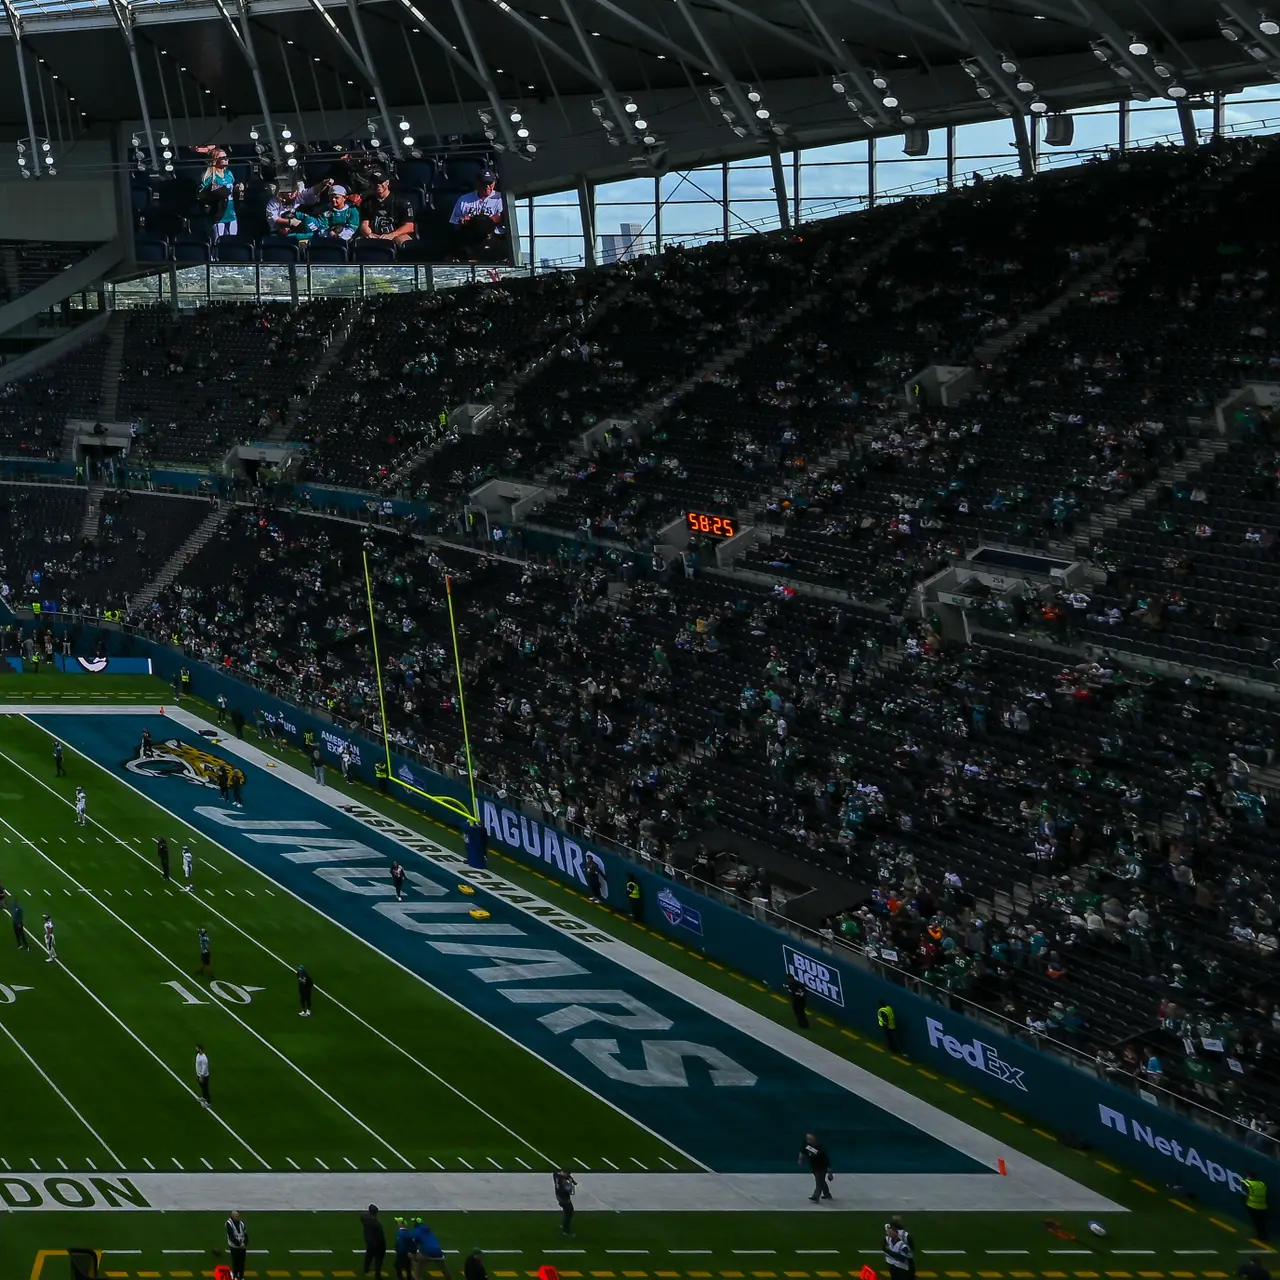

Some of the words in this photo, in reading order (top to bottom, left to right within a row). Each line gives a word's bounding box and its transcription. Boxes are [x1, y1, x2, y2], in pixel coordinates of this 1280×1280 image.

[689, 513, 734, 537] 58:25
[457, 869, 616, 944] CHANGE
[192, 805, 758, 1087] JAGUARS
[792, 953, 831, 983] BUD
[160, 978, 252, 1005] 10
[788, 964, 840, 1003] LIGHT
[925, 1016, 1028, 1092] FedEx
[1132, 1106, 1246, 1196] NetApp
